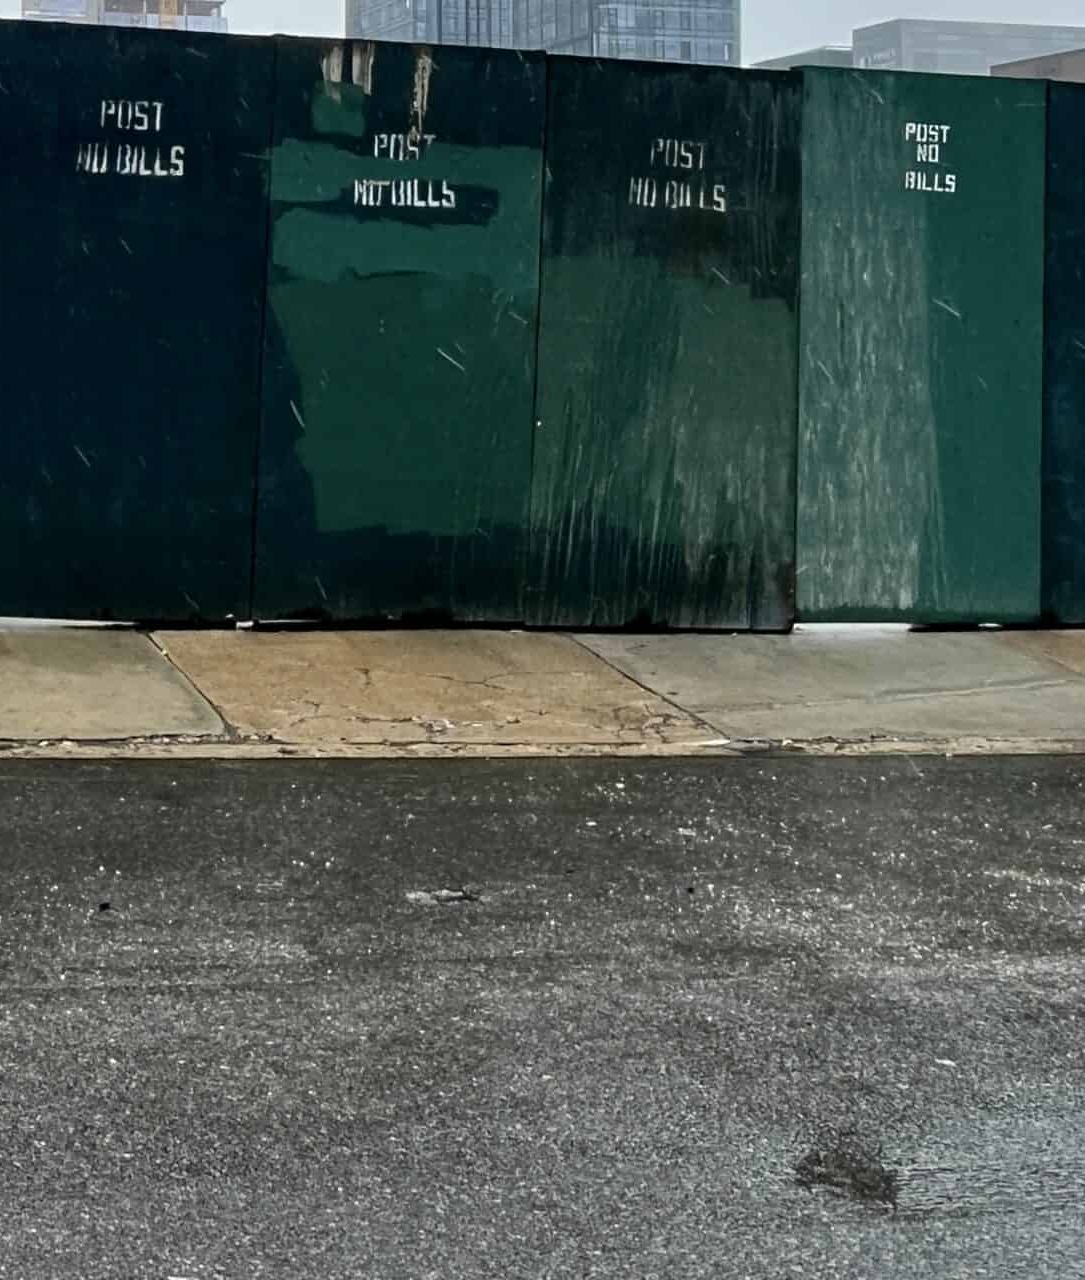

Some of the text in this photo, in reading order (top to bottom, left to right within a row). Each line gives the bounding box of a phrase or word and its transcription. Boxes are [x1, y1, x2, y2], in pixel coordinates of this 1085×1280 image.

[100, 99, 164, 132] POST
[374, 132, 437, 161] POST
[905, 122, 951, 144] POST
[75, 142, 185, 177] NO BILLS
[649, 137, 707, 169] POST
[916, 144, 939, 163] NO
[391, 178, 456, 208] BILLS
[628, 176, 727, 212] NO BILLS
[905, 171, 956, 193] BILLS
